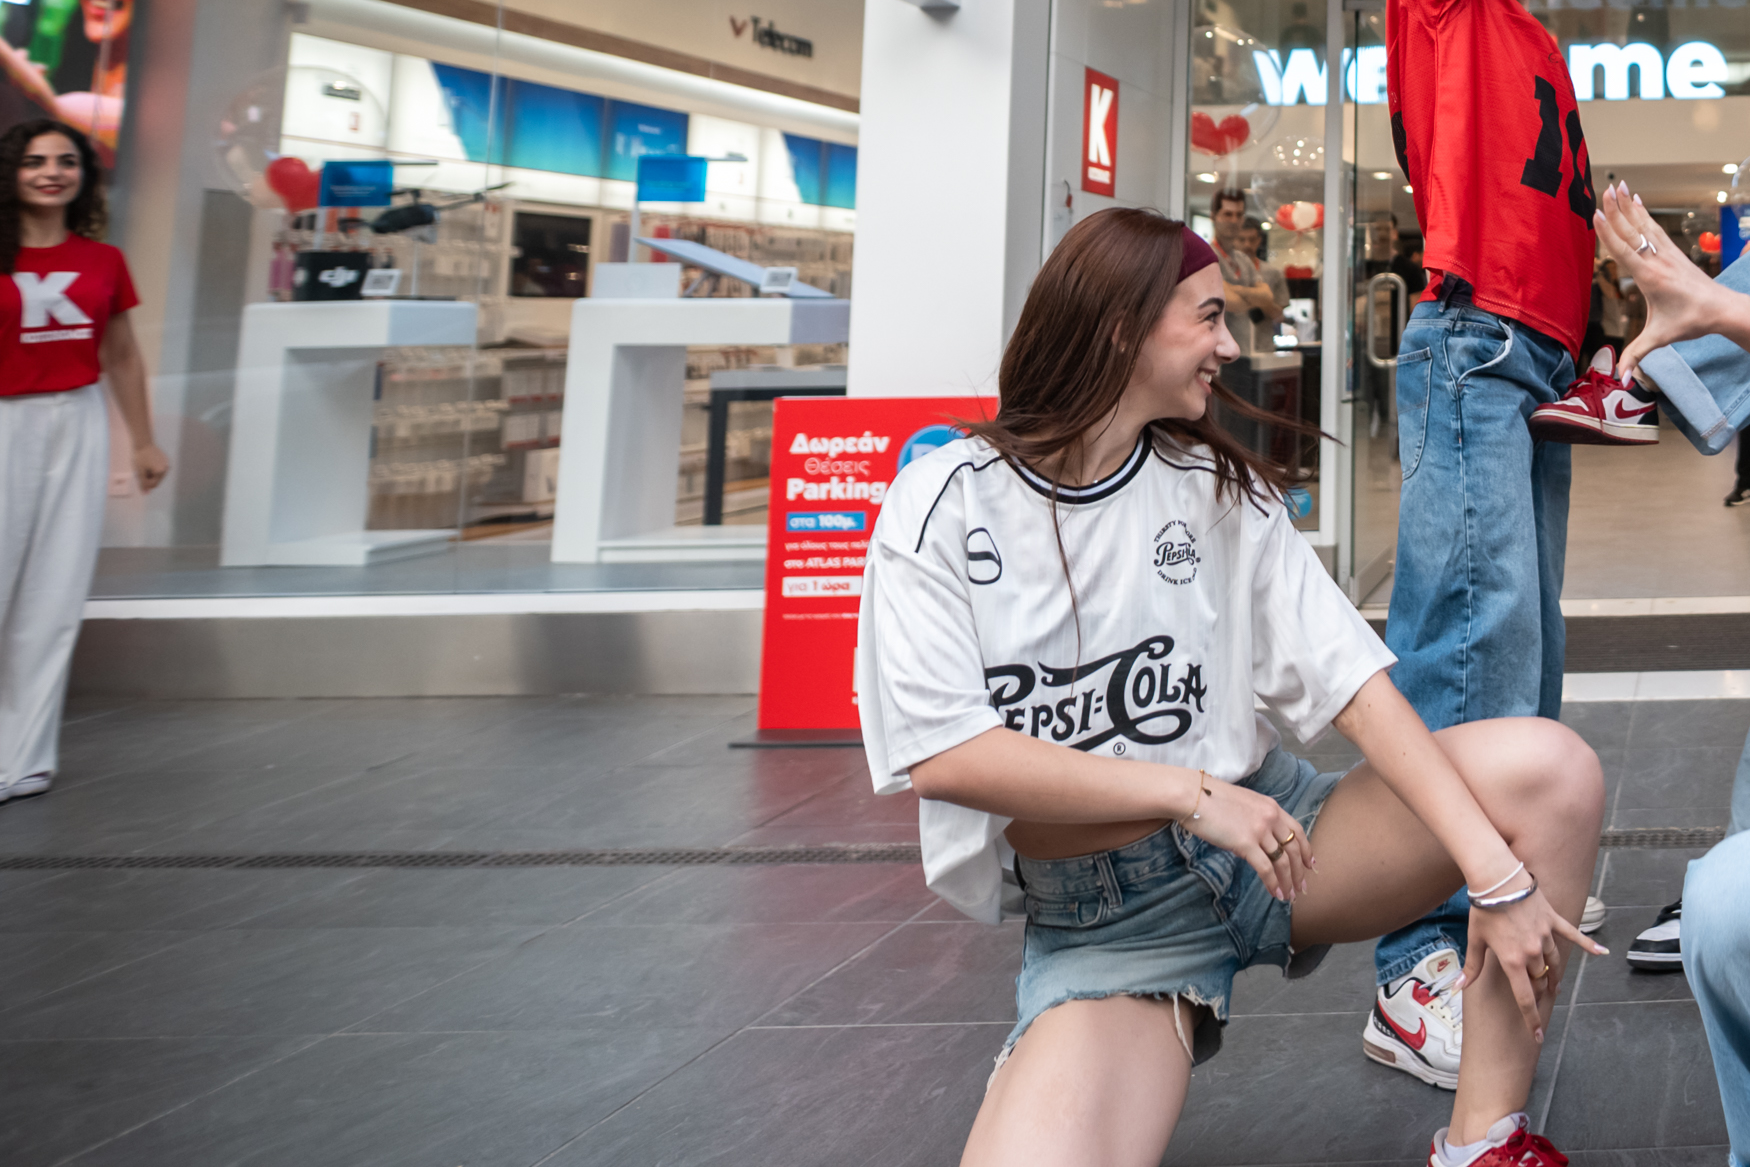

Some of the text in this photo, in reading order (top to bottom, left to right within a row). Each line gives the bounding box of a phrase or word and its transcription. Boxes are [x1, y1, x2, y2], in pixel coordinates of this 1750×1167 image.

[750, 14, 814, 60] Telecom
[789, 430, 891, 459] Δωρεάν
[804, 457, 871, 477] Θέσεις
[786, 475, 888, 505] Parking
[789, 516, 816, 529] στα
[805, 556, 841, 569] ATLAS
[1157, 569, 1178, 586] DRINK
